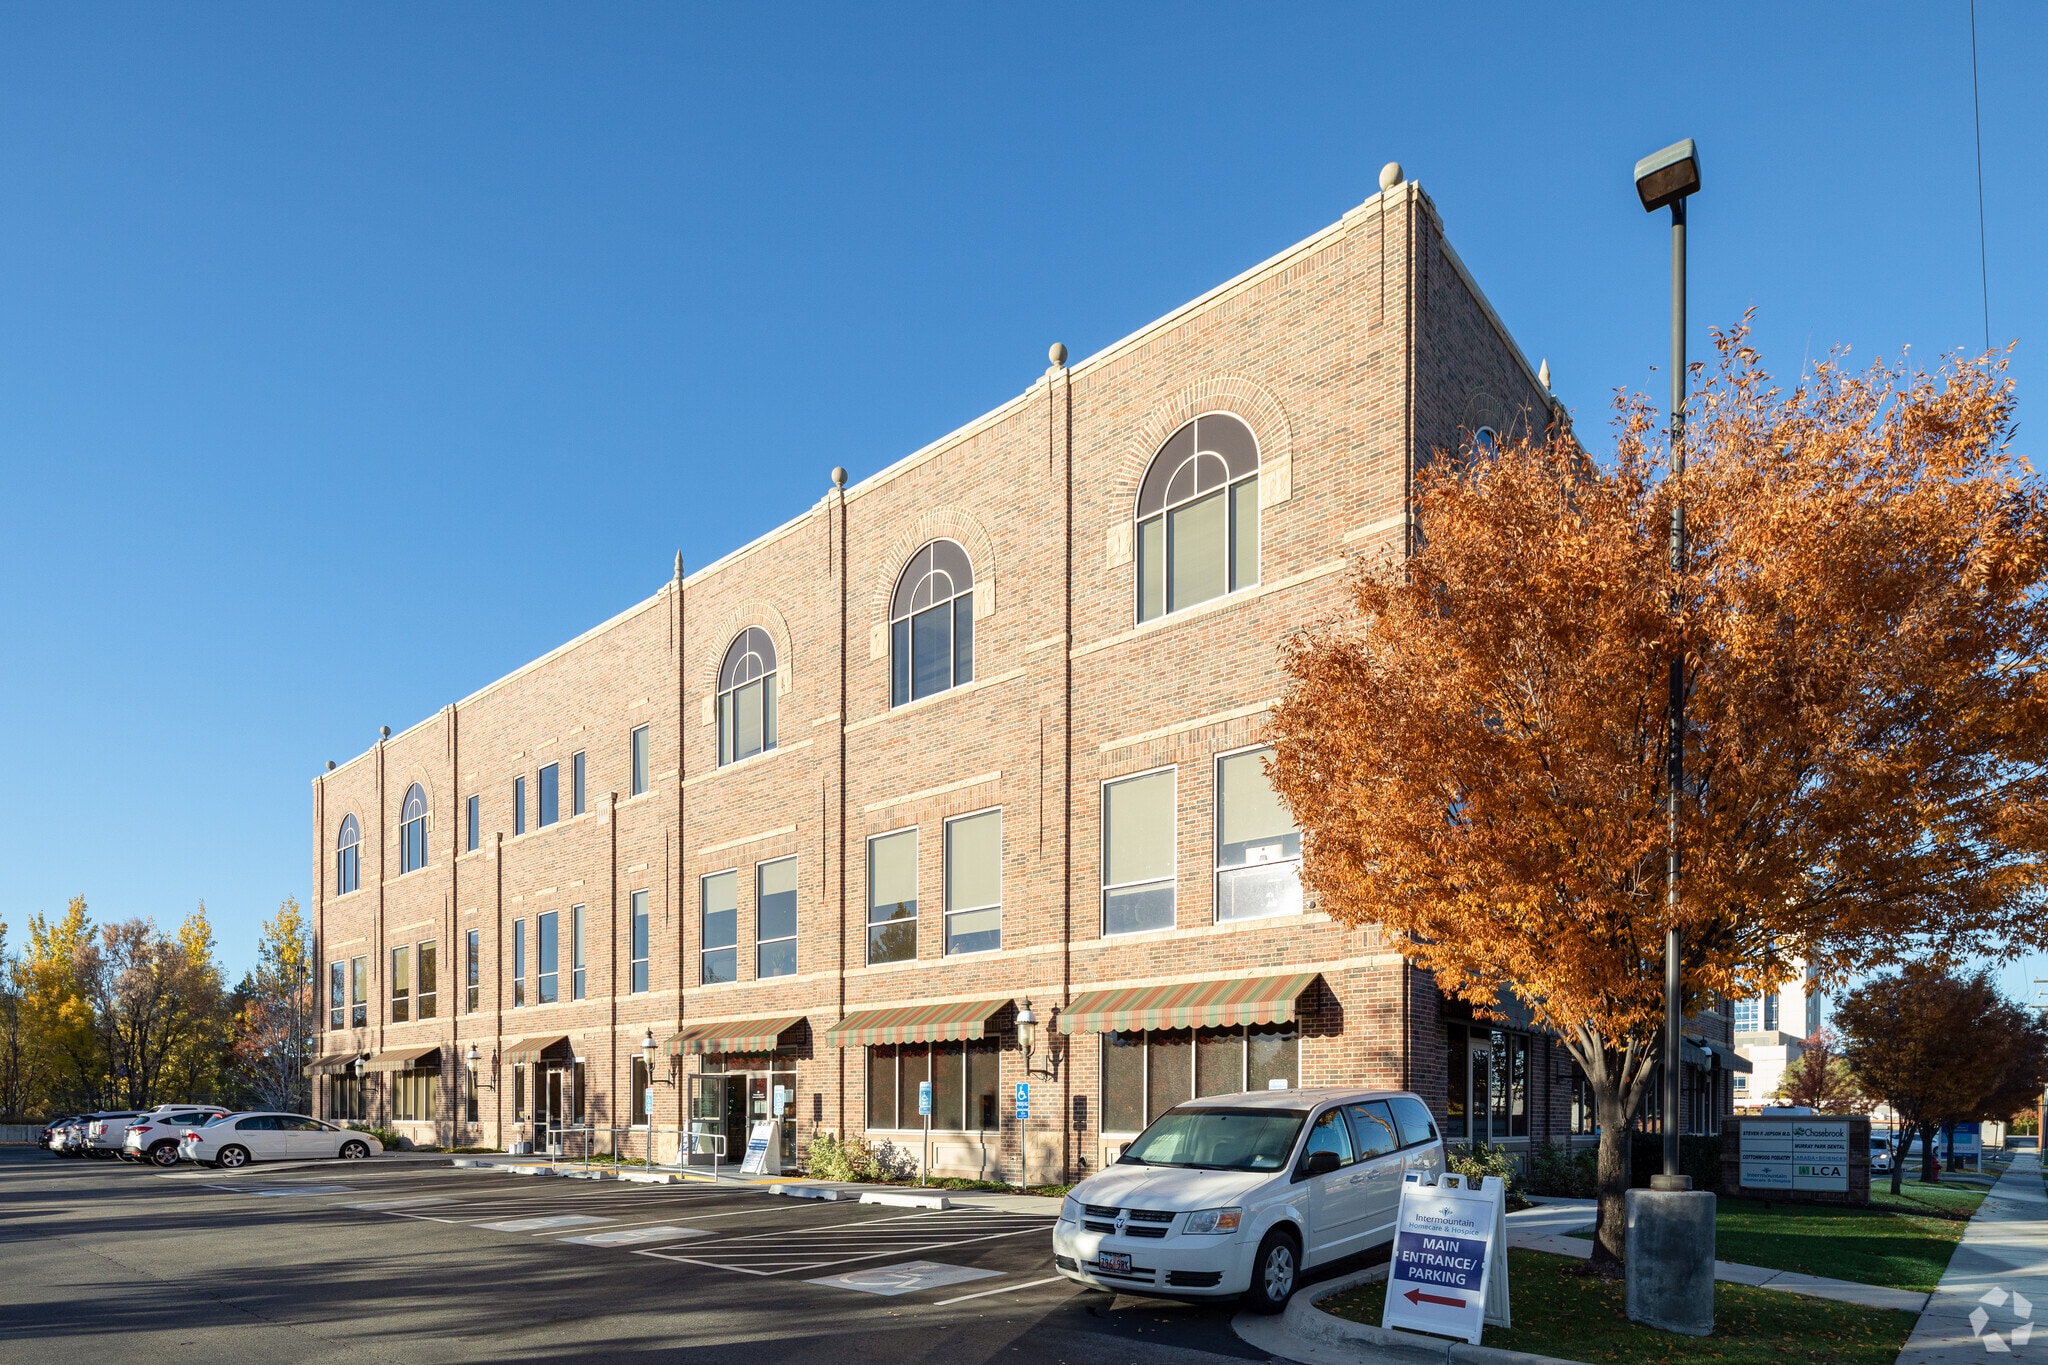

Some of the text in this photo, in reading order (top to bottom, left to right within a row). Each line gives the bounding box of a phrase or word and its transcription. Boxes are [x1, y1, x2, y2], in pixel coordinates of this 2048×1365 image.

[1805, 1128, 1844, 1137] Chasebrook
[1812, 1166, 1841, 1176] LCA
[1415, 1213, 1475, 1228] Intermountain
[1408, 1222, 1442, 1232] Homecare
[1451, 1227, 1479, 1236] Hospice
[1423, 1238, 1460, 1253] MAIN
[1402, 1250, 1478, 1270] ENTRANCE/
[1408, 1266, 1466, 1285] PARKING
